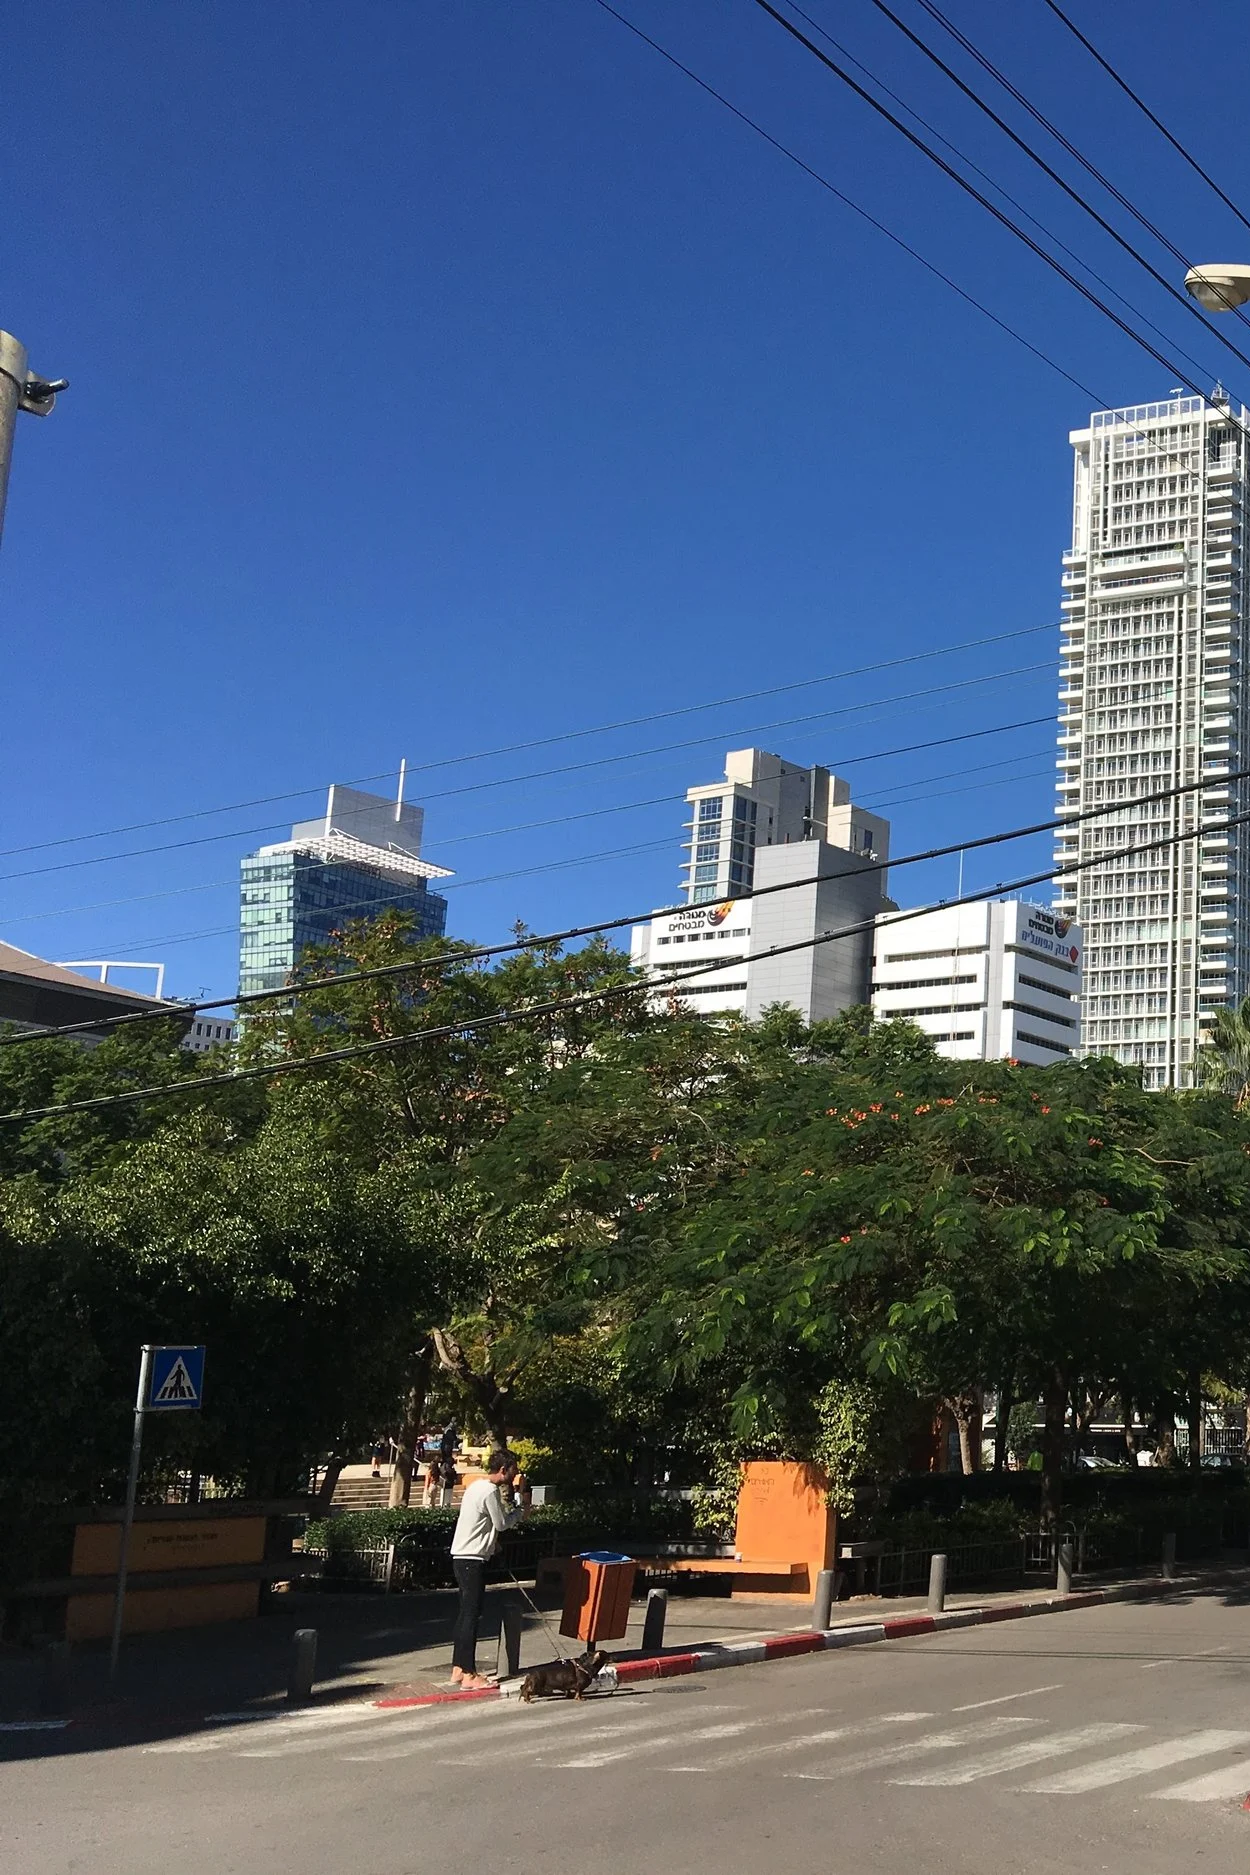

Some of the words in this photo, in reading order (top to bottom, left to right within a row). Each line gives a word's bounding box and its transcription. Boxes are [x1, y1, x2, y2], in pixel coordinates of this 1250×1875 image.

[669, 920, 705, 931] מבטחים
[1021, 930, 1054, 951] הפועלים
[1055, 943, 1069, 957] בנק
